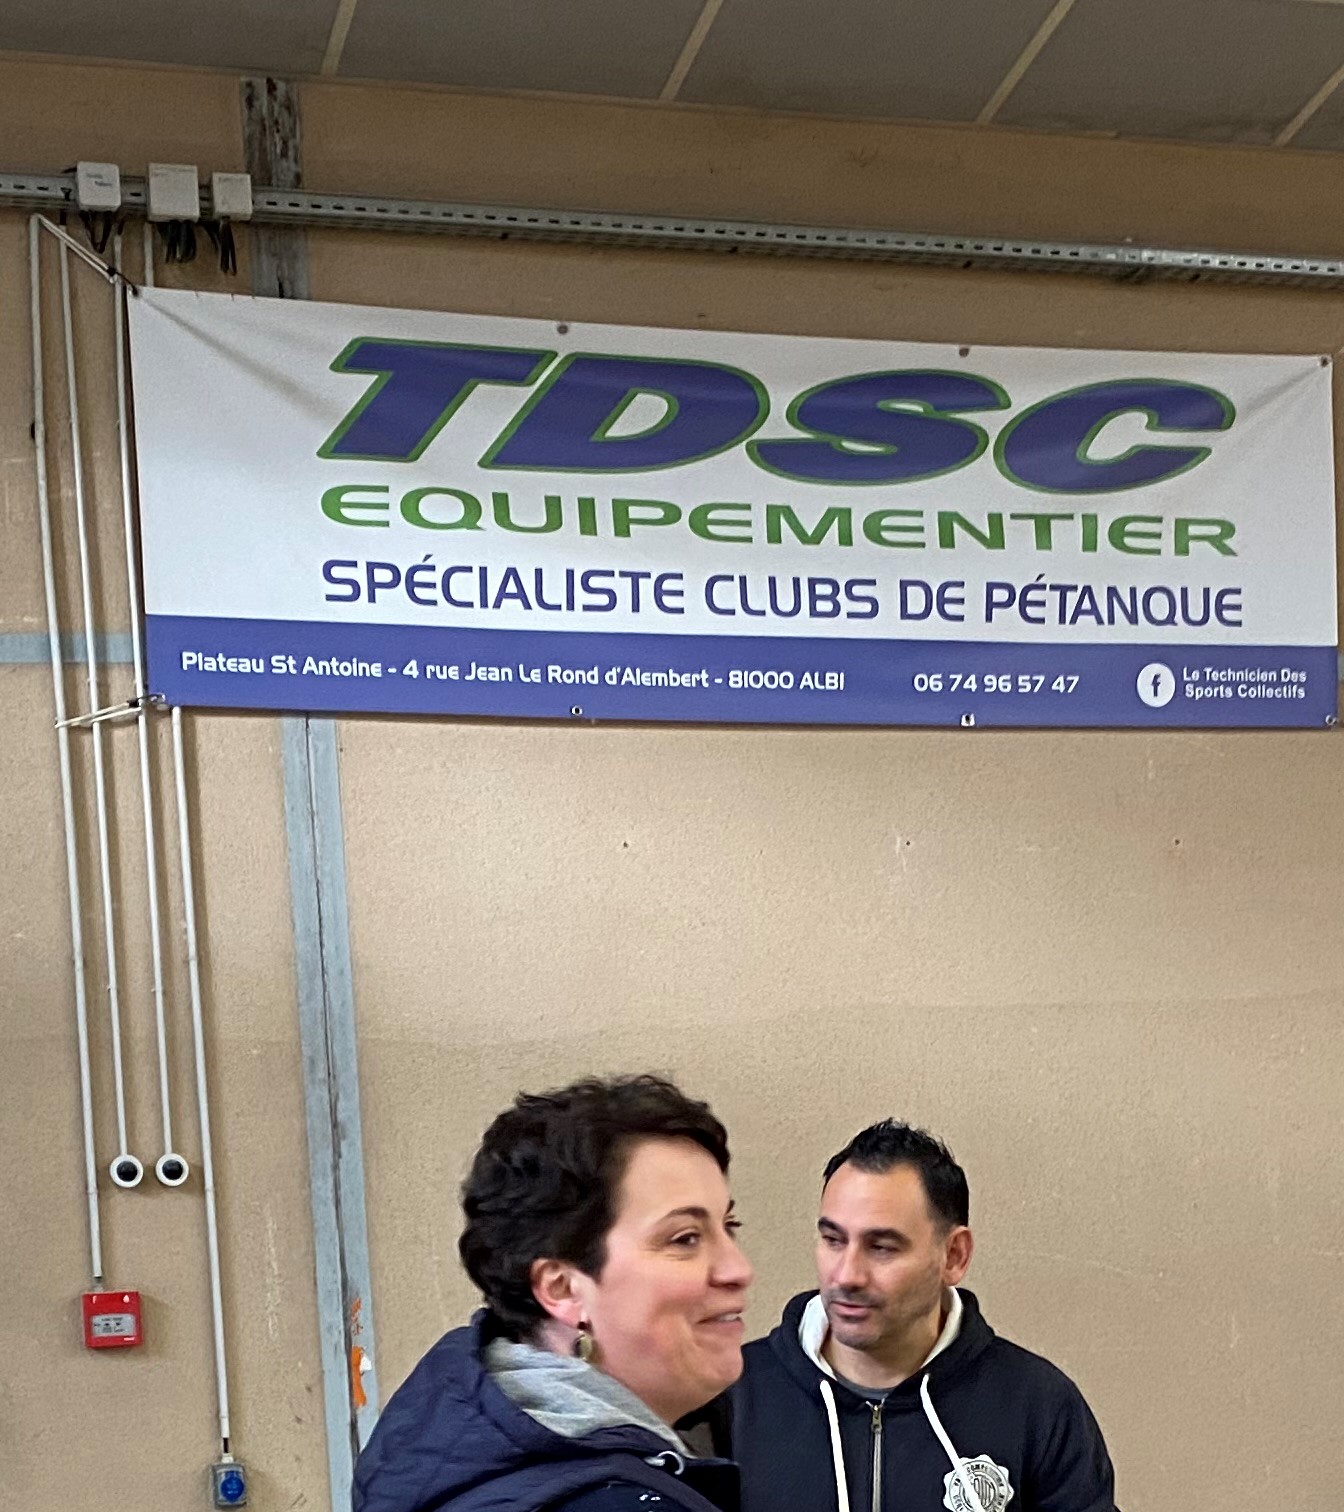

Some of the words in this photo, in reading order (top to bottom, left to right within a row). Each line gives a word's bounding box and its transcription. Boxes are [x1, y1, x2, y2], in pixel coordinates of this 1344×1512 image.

[316, 336, 1237, 495] TDSC
[316, 484, 1240, 557] EQUIPEMENTIER
[322, 554, 685, 615] SPÉCIALISTE
[704, 574, 879, 620] CLUBS
[899, 579, 966, 622] DE
[985, 573, 1244, 628] PÉTANQUE
[181, 651, 264, 674] Plateau
[271, 655, 297, 675] St
[302, 656, 383, 678] Antoine
[403, 659, 420, 679] 4
[426, 664, 460, 681] rue
[465, 661, 513, 682] Jean
[519, 664, 542, 684] Le
[548, 665, 600, 685] Rond
[605, 666, 710, 688] d'Alembert
[728, 669, 794, 690] 81000
[799, 671, 845, 691] ALBI
[913, 673, 944, 692] 06
[949, 673, 978, 693] 74
[983, 674, 1012, 693] 96
[1018, 674, 1045, 693] 57
[1051, 675, 1080, 693] 47
[1183, 666, 1200, 682] Le
[1204, 666, 1277, 682] Technicien
[1280, 668, 1307, 683] Des
[1185, 684, 1233, 700] Sports
[1237, 684, 1306, 699] Collectifs
